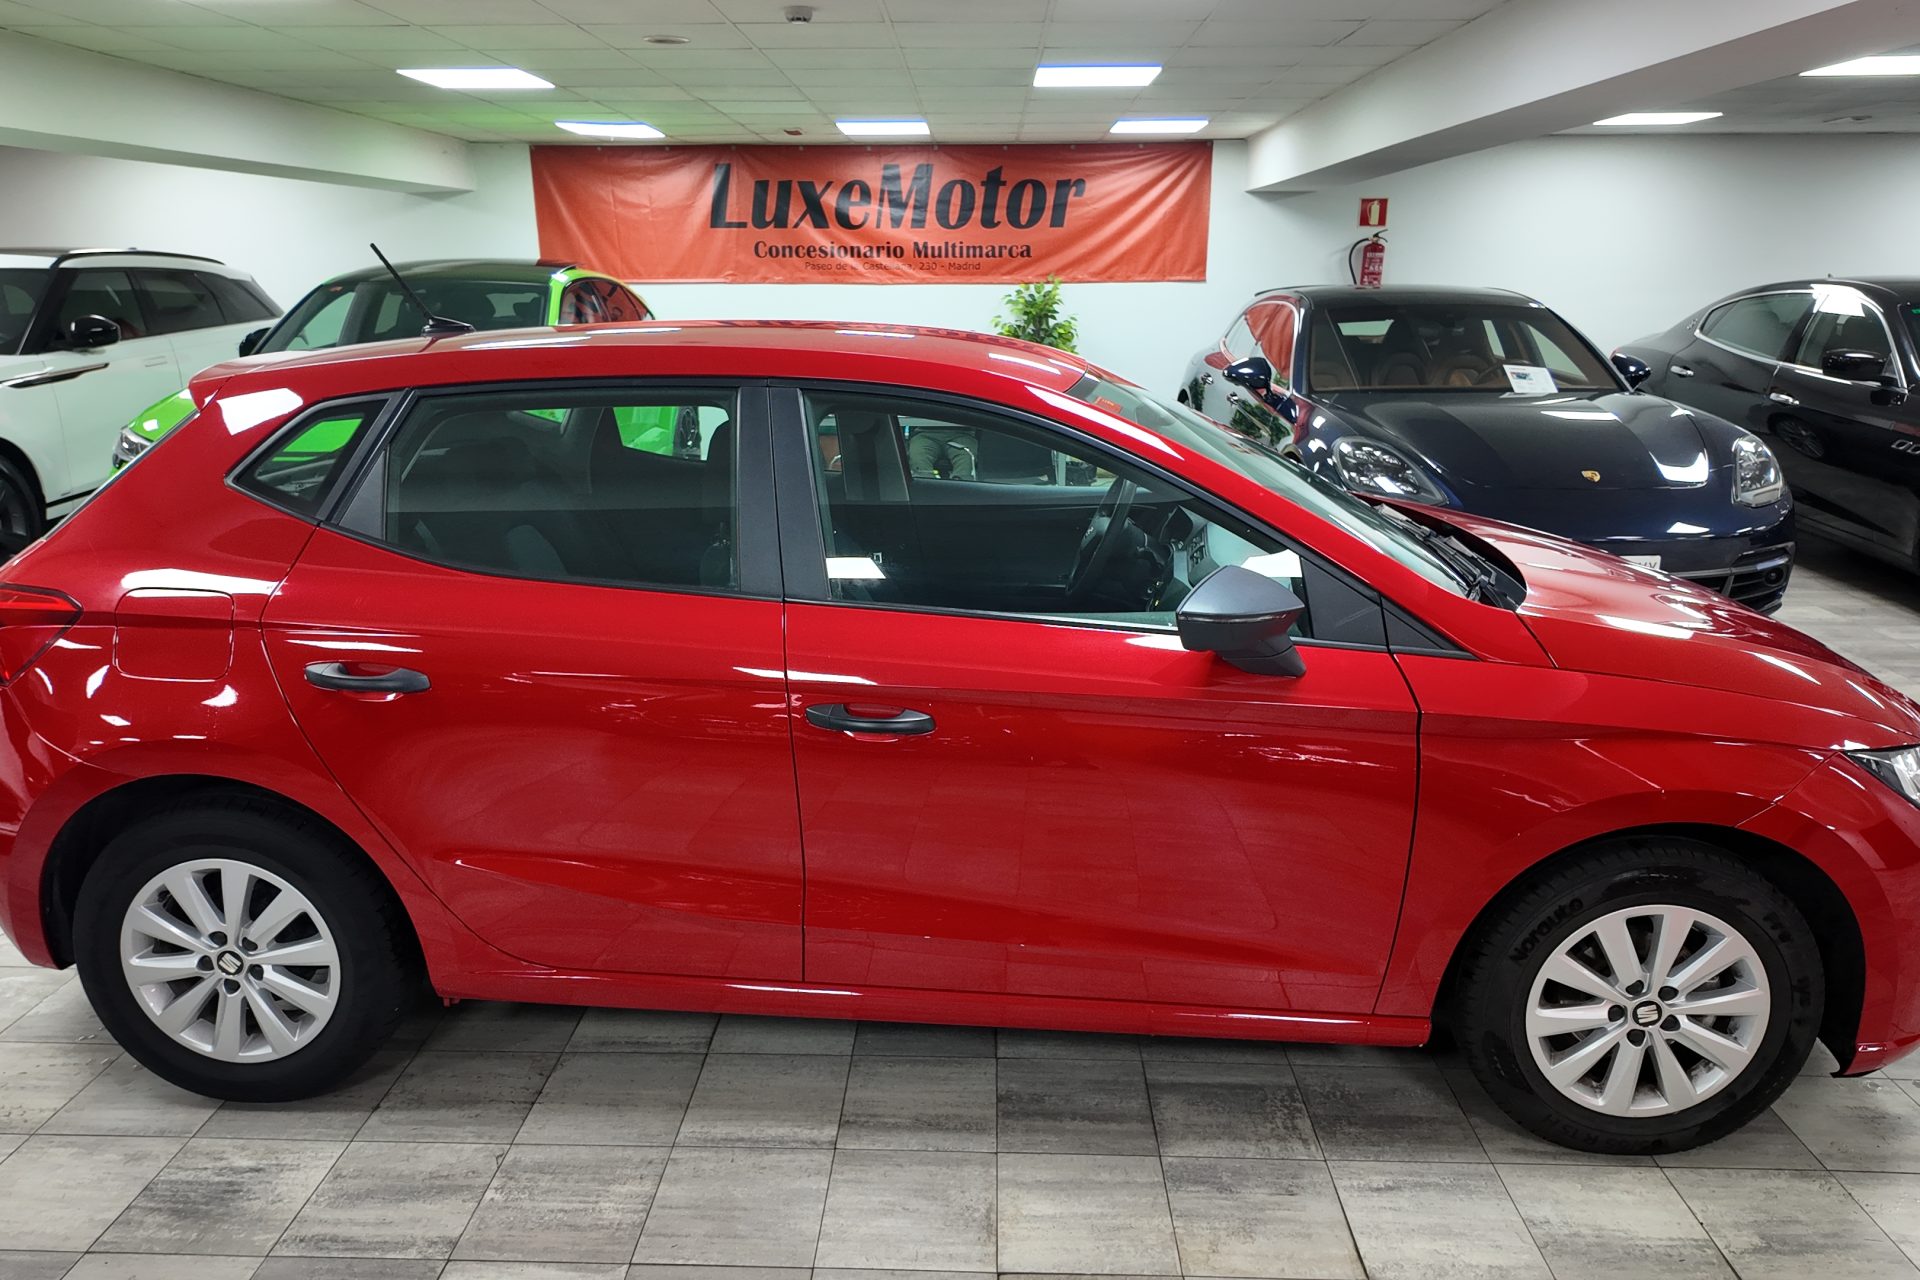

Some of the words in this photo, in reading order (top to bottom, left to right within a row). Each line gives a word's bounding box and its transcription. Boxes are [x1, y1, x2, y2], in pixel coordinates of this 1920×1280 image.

[710, 163, 1086, 230] LuxeMotor
[754, 241, 905, 259] Concesionario
[912, 241, 1032, 259] Multimarca
[805, 261, 833, 271] Paseo
[836, 261, 848, 271] de
[863, 261, 916, 272] Casteana,
[919, 261, 938, 271] 230
[948, 261, 981, 271] Madrid
[1508, 897, 1584, 966] Norauto
